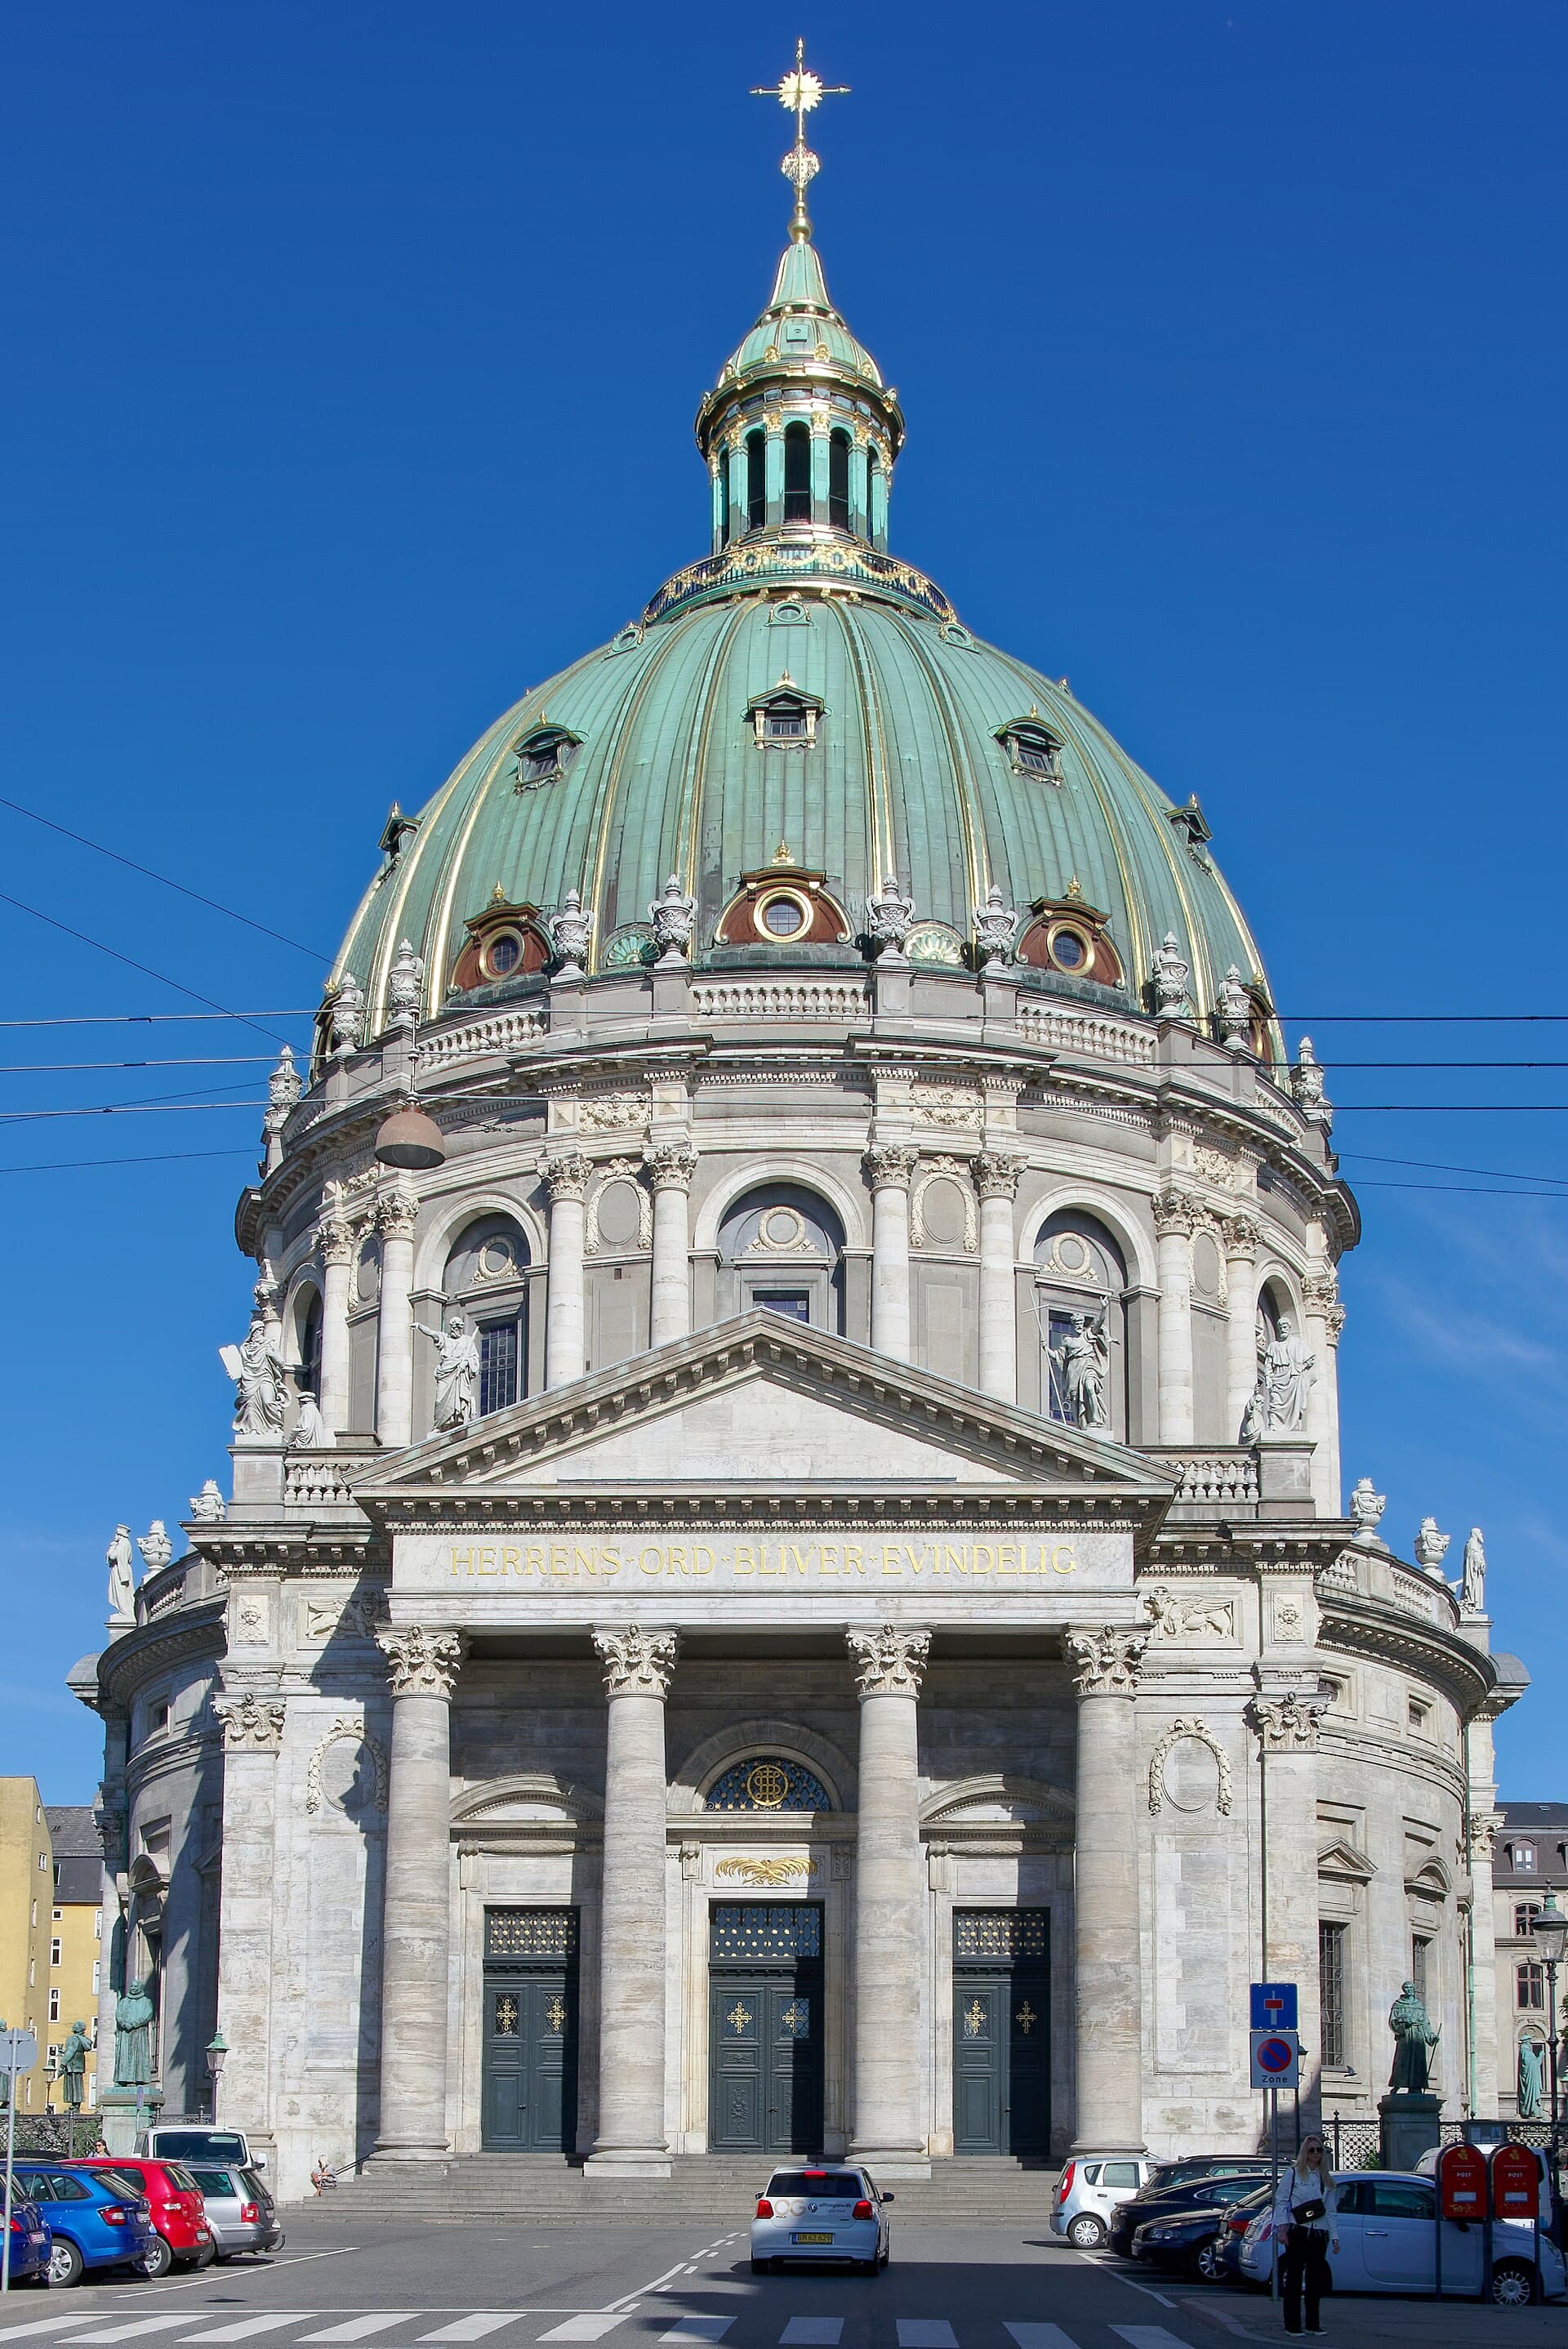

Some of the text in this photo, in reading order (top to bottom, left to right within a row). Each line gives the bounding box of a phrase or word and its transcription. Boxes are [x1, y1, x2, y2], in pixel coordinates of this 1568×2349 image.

[450, 1545, 1076, 1576] HERRENS ORD BLIVER EVINDELIG
[1262, 2075, 1288, 2083] Zone
[775, 2200, 806, 2216] OG
